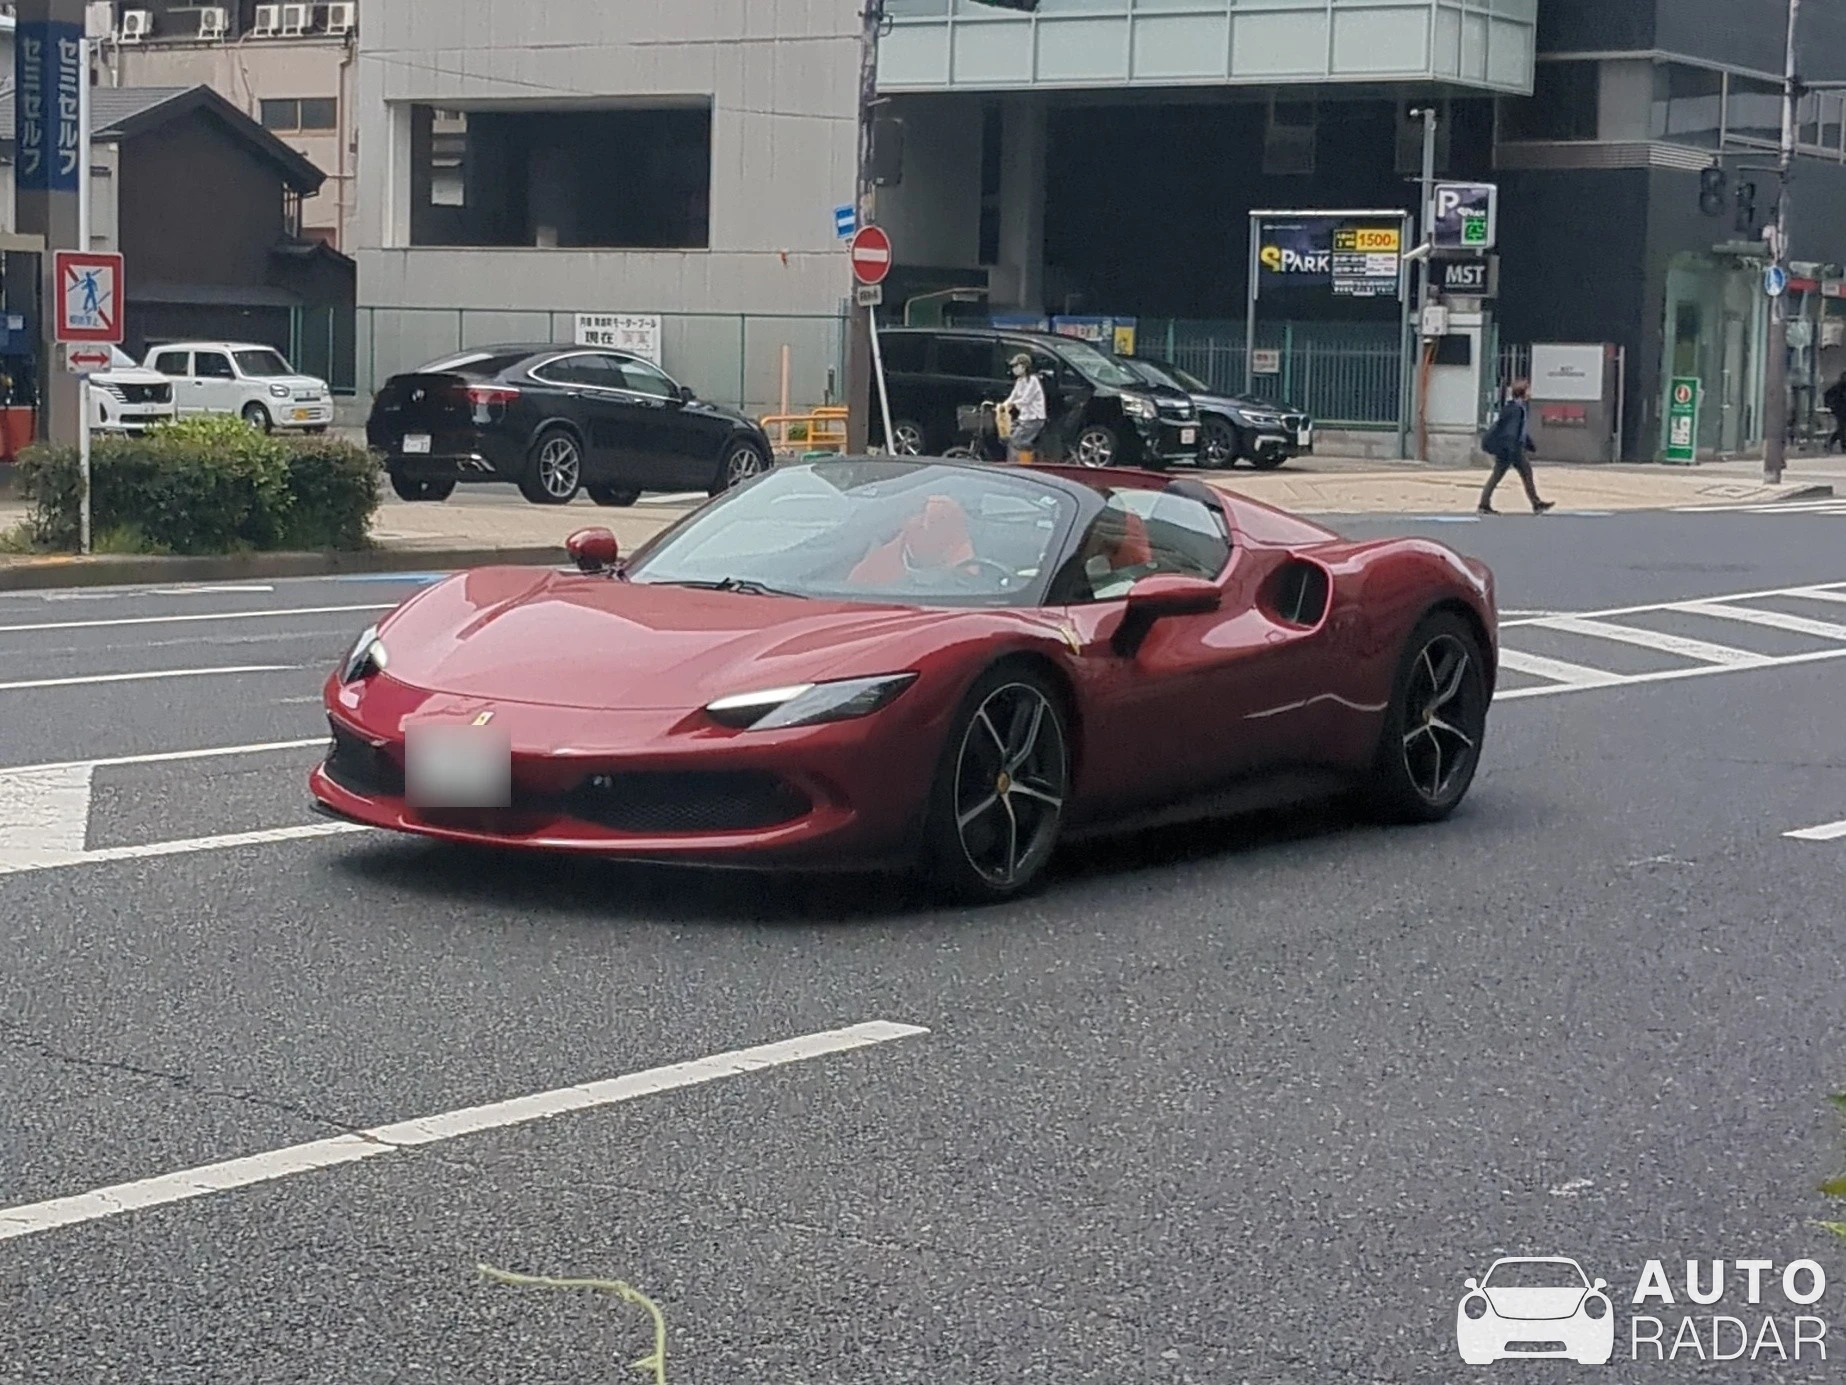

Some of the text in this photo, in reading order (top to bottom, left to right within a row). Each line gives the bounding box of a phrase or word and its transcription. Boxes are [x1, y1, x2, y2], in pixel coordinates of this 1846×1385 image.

[22, 37, 42, 175] セミセルフ
[57, 37, 78, 175] セミセルフ
[1438, 190, 1459, 217] P
[1445, 265, 1485, 284] MST
